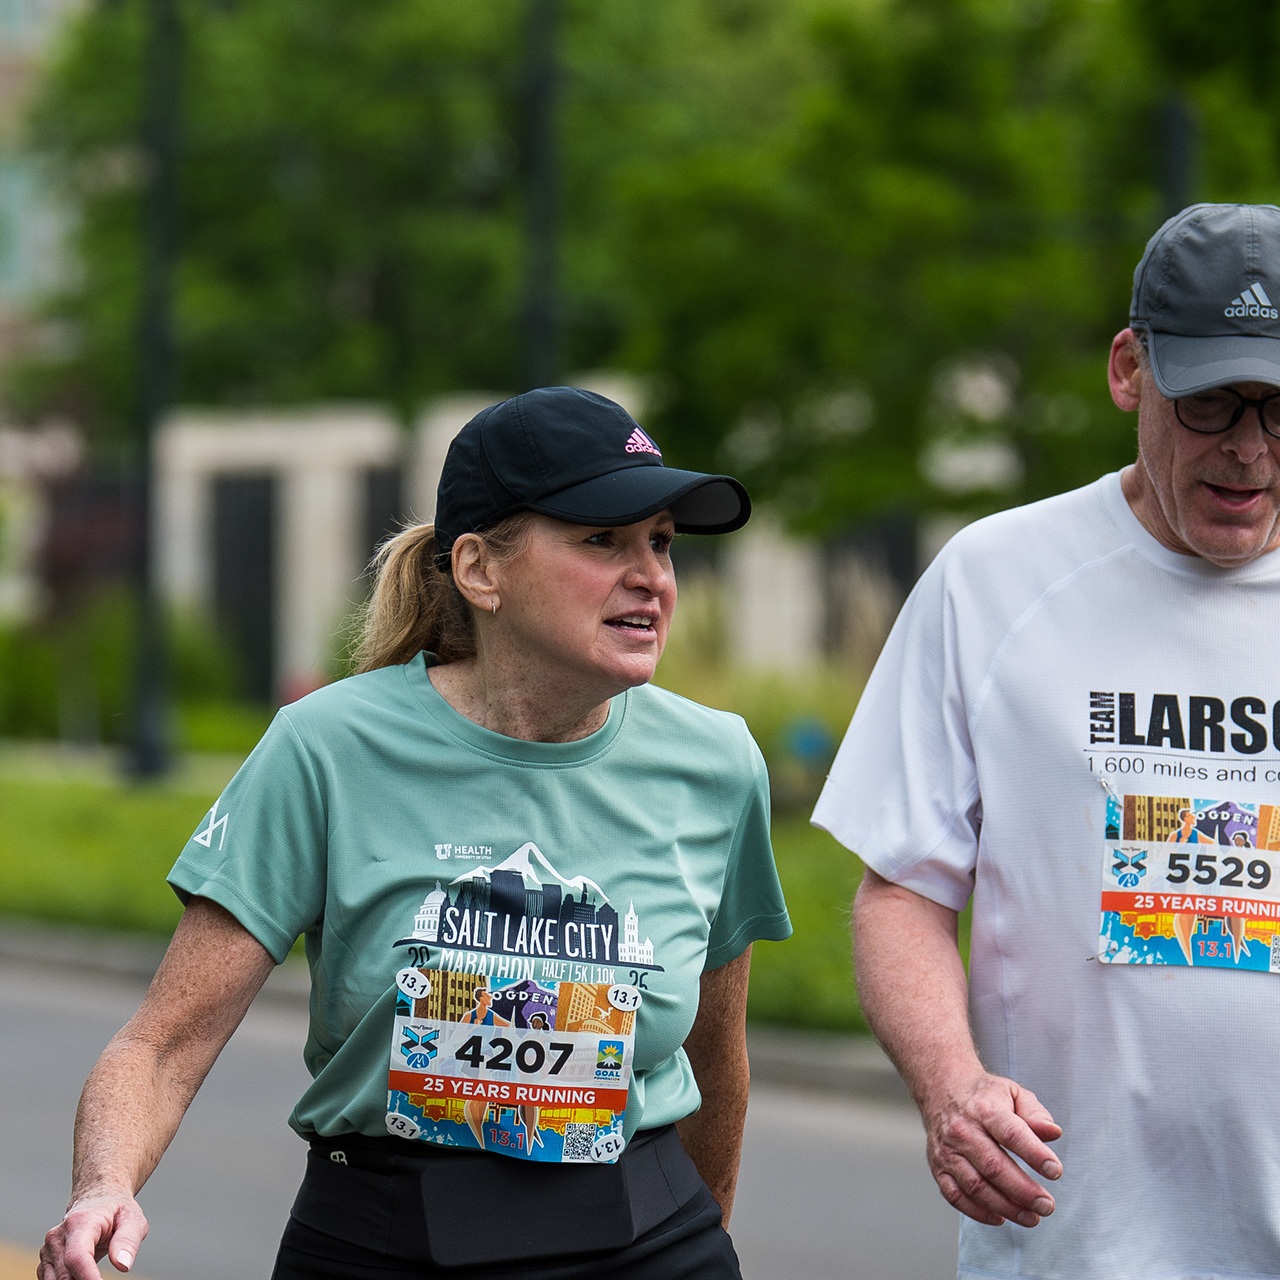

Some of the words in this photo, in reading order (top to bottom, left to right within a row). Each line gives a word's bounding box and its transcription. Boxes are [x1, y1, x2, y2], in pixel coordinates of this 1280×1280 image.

[1224, 303, 1279, 320] adidas
[1089, 691, 1115, 745] TEAM
[1153, 761, 1209, 781] miles
[1216, 766, 1257, 783] and
[1196, 811, 1255, 826] OGDEN
[454, 845, 492, 855] HEALTH
[1165, 852, 1272, 890] 5529
[1133, 895, 1155, 909] 25
[1160, 896, 1218, 912] YEARS
[442, 906, 498, 949] SALT
[502, 913, 559, 957] LAKE
[564, 922, 614, 961] CITY
[1197, 941, 1232, 958] 13.1
[438, 947, 536, 979] MARATHON
[541, 960, 568, 980] HALF
[574, 965, 590, 983] 5K
[596, 967, 616, 985] 10K
[400, 972, 428, 996] 13.1
[492, 989, 554, 1006] OGDEN
[610, 988, 639, 1008] 13.1
[454, 1035, 574, 1076] 4207
[595, 1069, 621, 1078] GOAL
[422, 1077, 445, 1092] 25
[449, 1079, 511, 1100] YEARS
[516, 1085, 597, 1104] RUNNING
[389, 1116, 418, 1137] 13.1
[489, 1128, 524, 1149] 13.1
